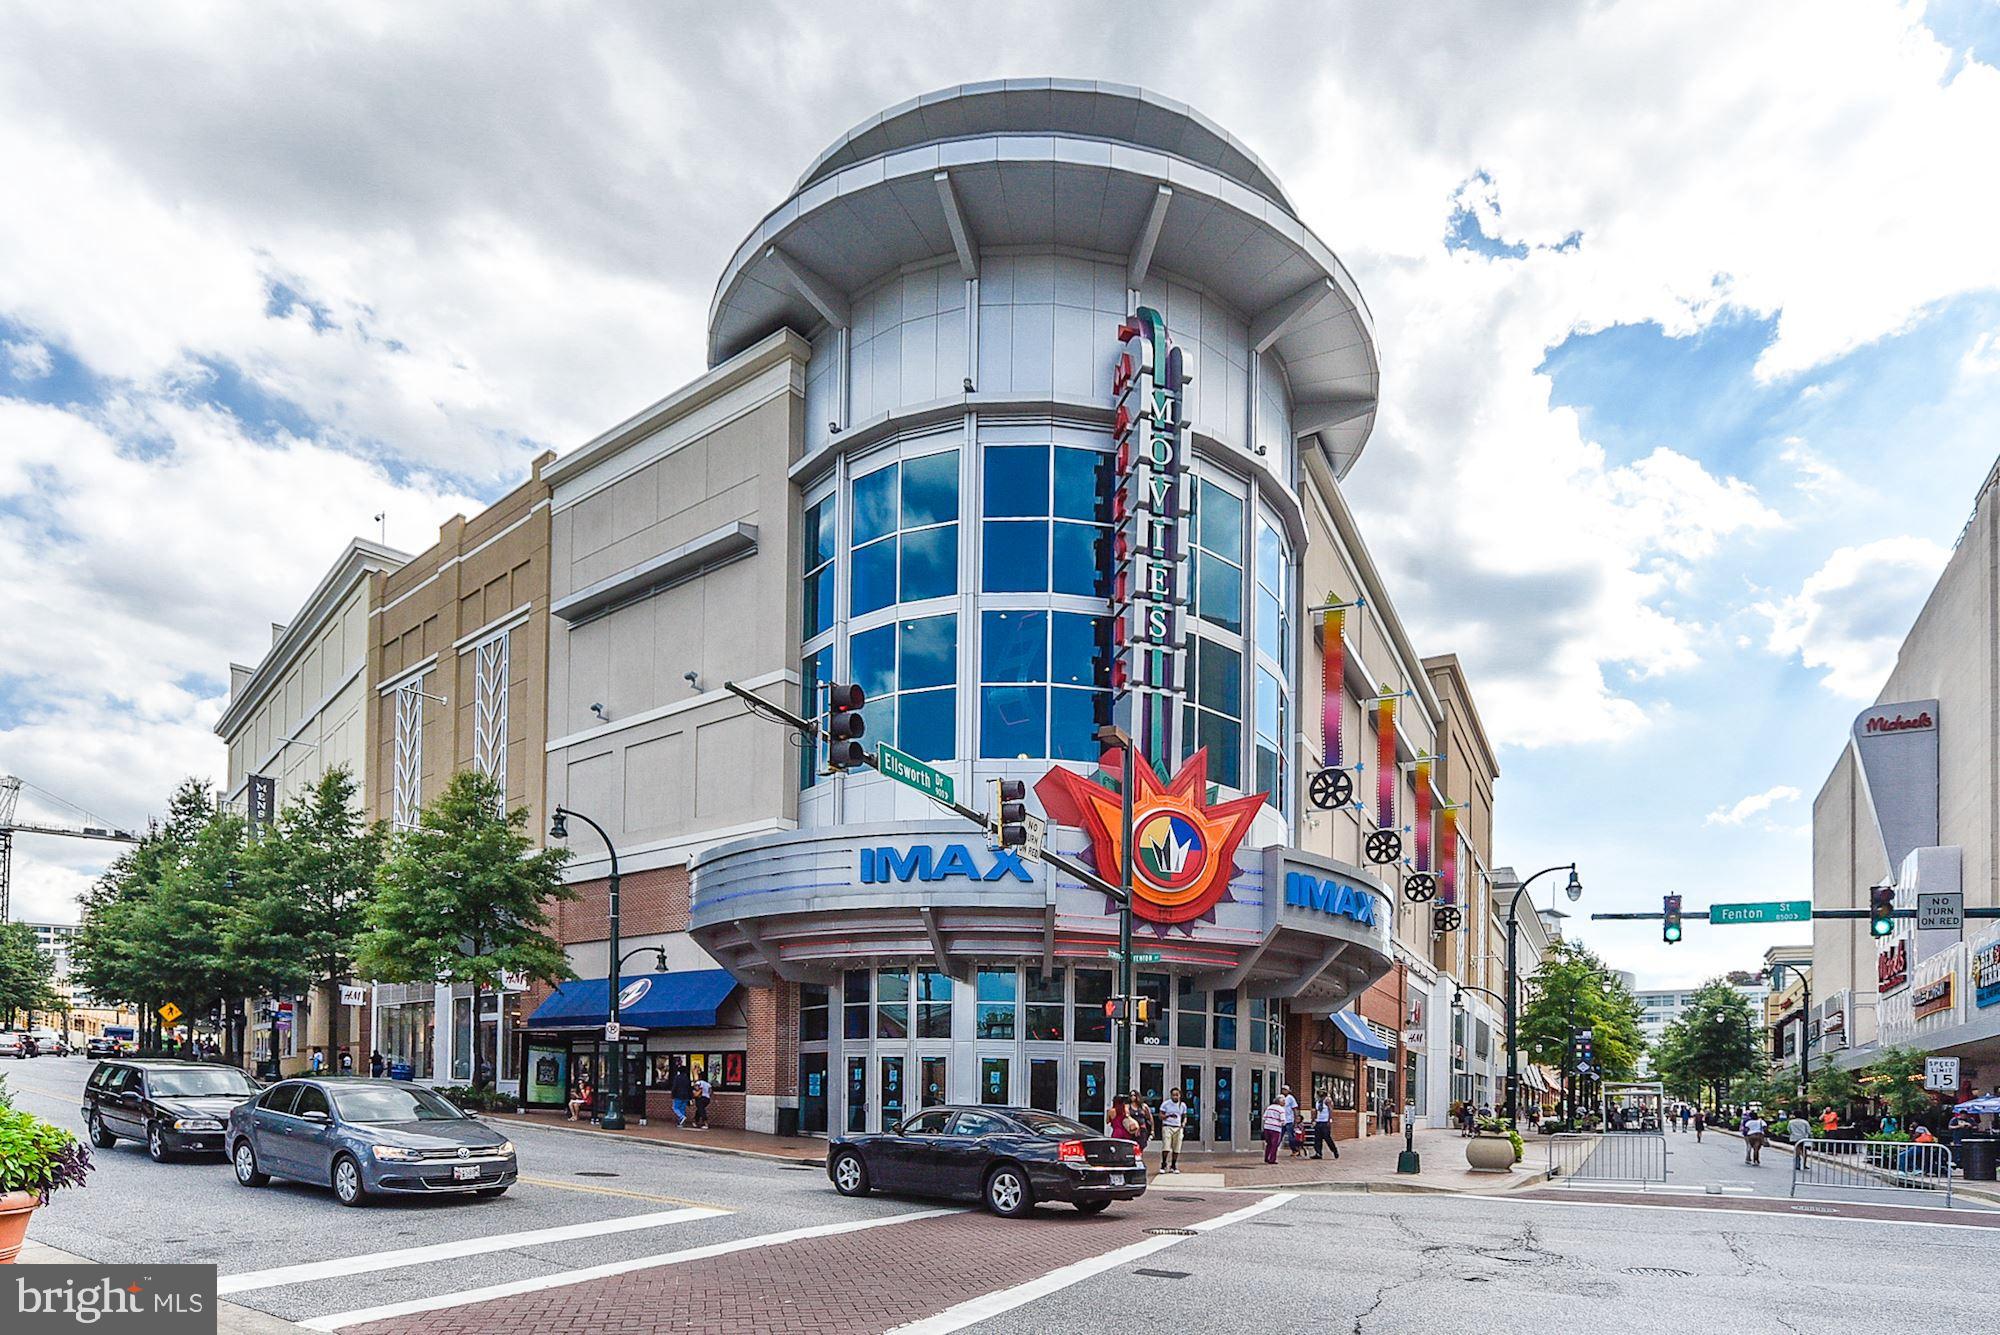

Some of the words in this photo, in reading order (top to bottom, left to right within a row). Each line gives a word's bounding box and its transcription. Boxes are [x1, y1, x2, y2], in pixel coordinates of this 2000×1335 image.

[1148, 389, 1175, 638] MOVIES
[1866, 712, 1932, 733] Michaels
[885, 752, 931, 788] Ellsworth
[935, 773, 944, 787] Dr
[1028, 820, 1039, 832] NO
[861, 844, 1033, 883] IMAX
[1286, 871, 1376, 926] IMAX
[1932, 897, 1949, 905] NO
[1722, 909, 1763, 920] Fenton
[1780, 903, 1790, 911] St
[1928, 907, 1954, 915] TURN
[1921, 917, 1935, 925] ON
[1940, 917, 1960, 925] RED
[1143, 1036, 1160, 1045] 900
[1933, 1074, 1953, 1086] 15
